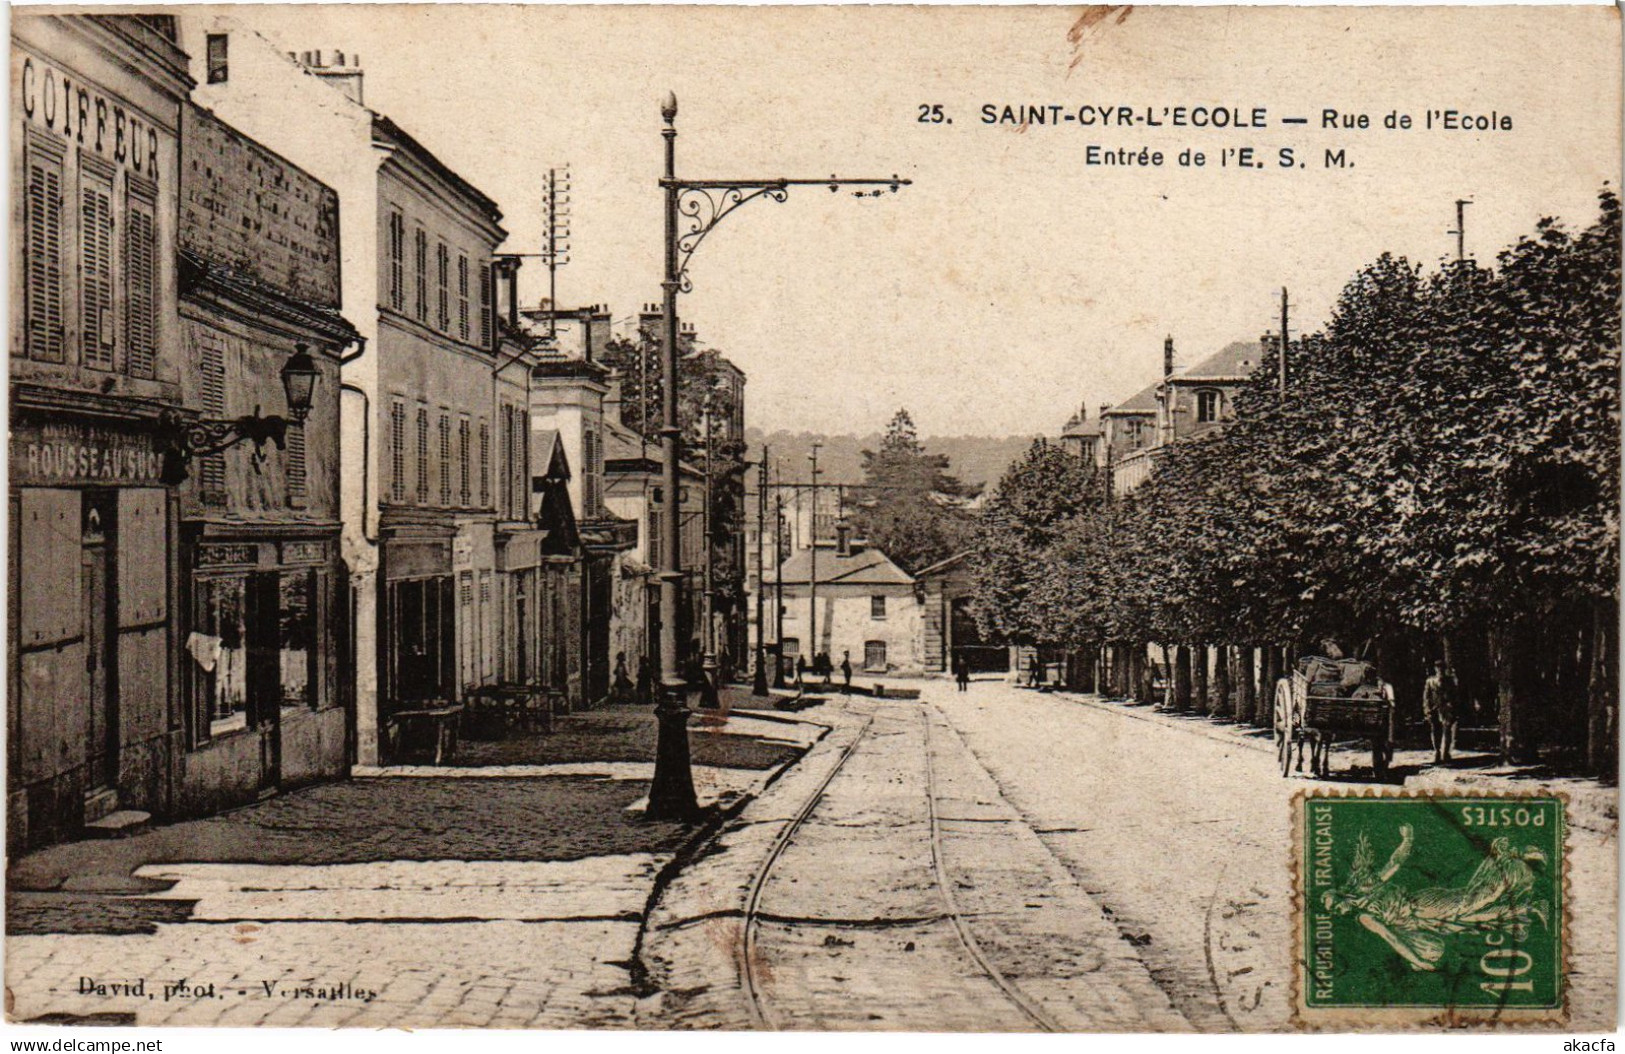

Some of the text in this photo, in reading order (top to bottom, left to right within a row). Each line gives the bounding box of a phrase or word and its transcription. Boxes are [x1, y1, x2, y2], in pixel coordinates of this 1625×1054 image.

[22, 58, 160, 181] COIFFEUR
[27, 443, 121, 479] ROUSSEAU
[1314, 805, 1334, 886] FRANÇAISE
[1461, 806, 1546, 828] POSTES
